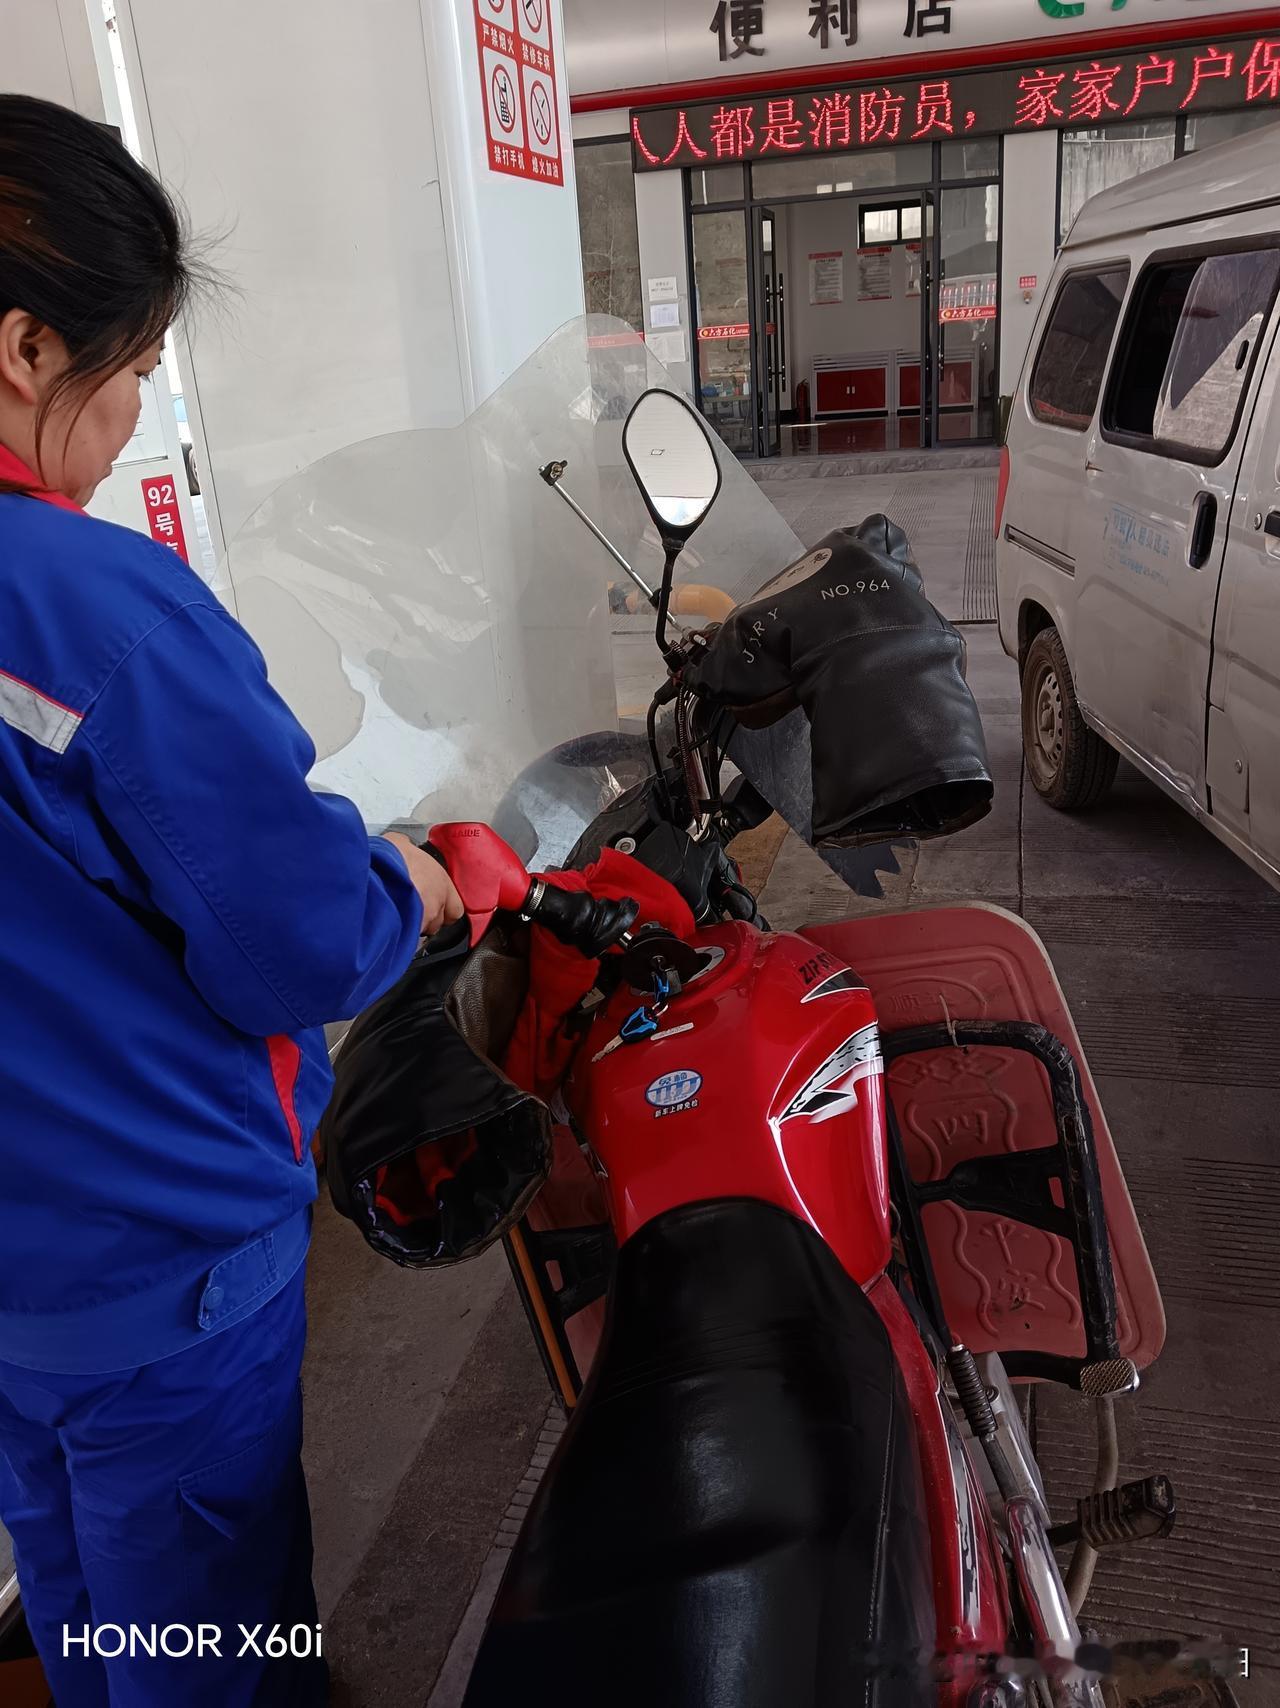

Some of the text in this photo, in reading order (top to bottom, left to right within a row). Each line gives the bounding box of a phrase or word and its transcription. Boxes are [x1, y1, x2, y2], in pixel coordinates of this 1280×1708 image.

[709, 0, 951, 61] 便利店
[820, 579, 890, 600] NO.964
